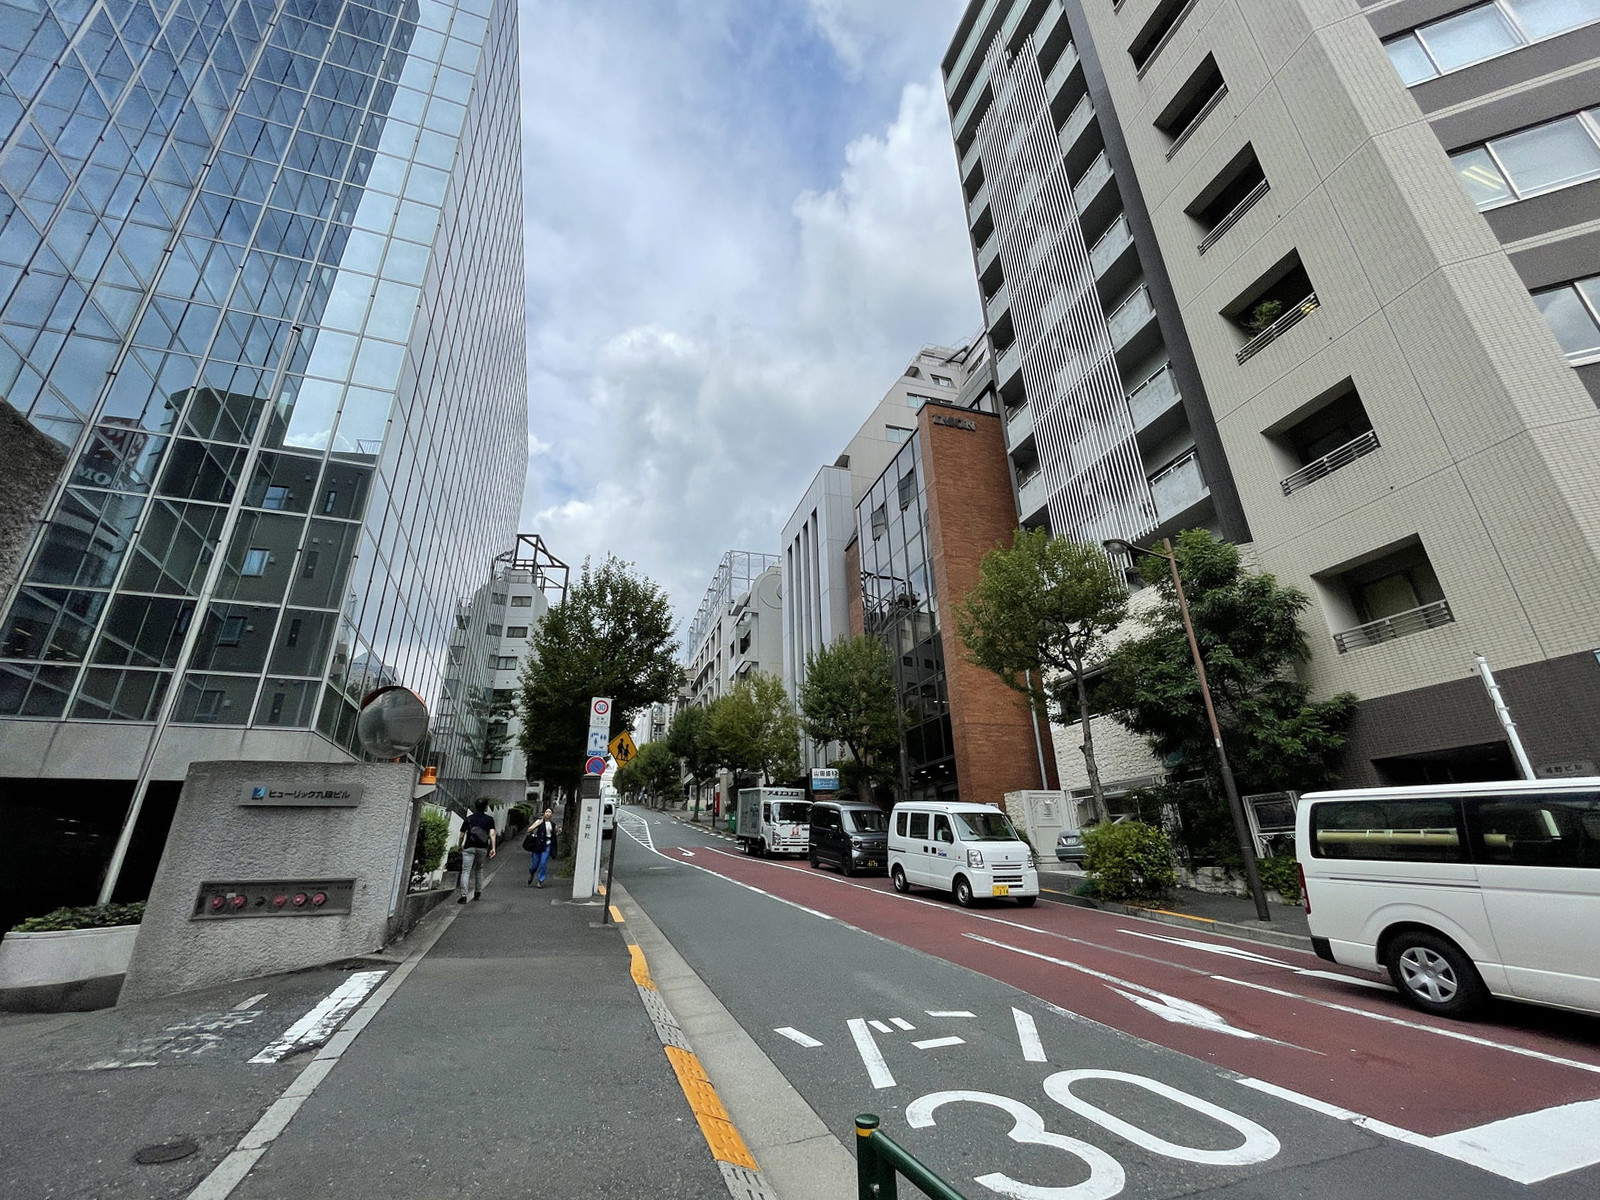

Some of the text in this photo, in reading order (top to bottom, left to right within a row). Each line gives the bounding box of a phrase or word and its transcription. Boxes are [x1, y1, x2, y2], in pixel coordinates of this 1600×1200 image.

[597, 703, 606, 711] 30
[268, 789, 351, 799] ヒューリック九段ビル
[905, 1068, 1281, 1200] 30
